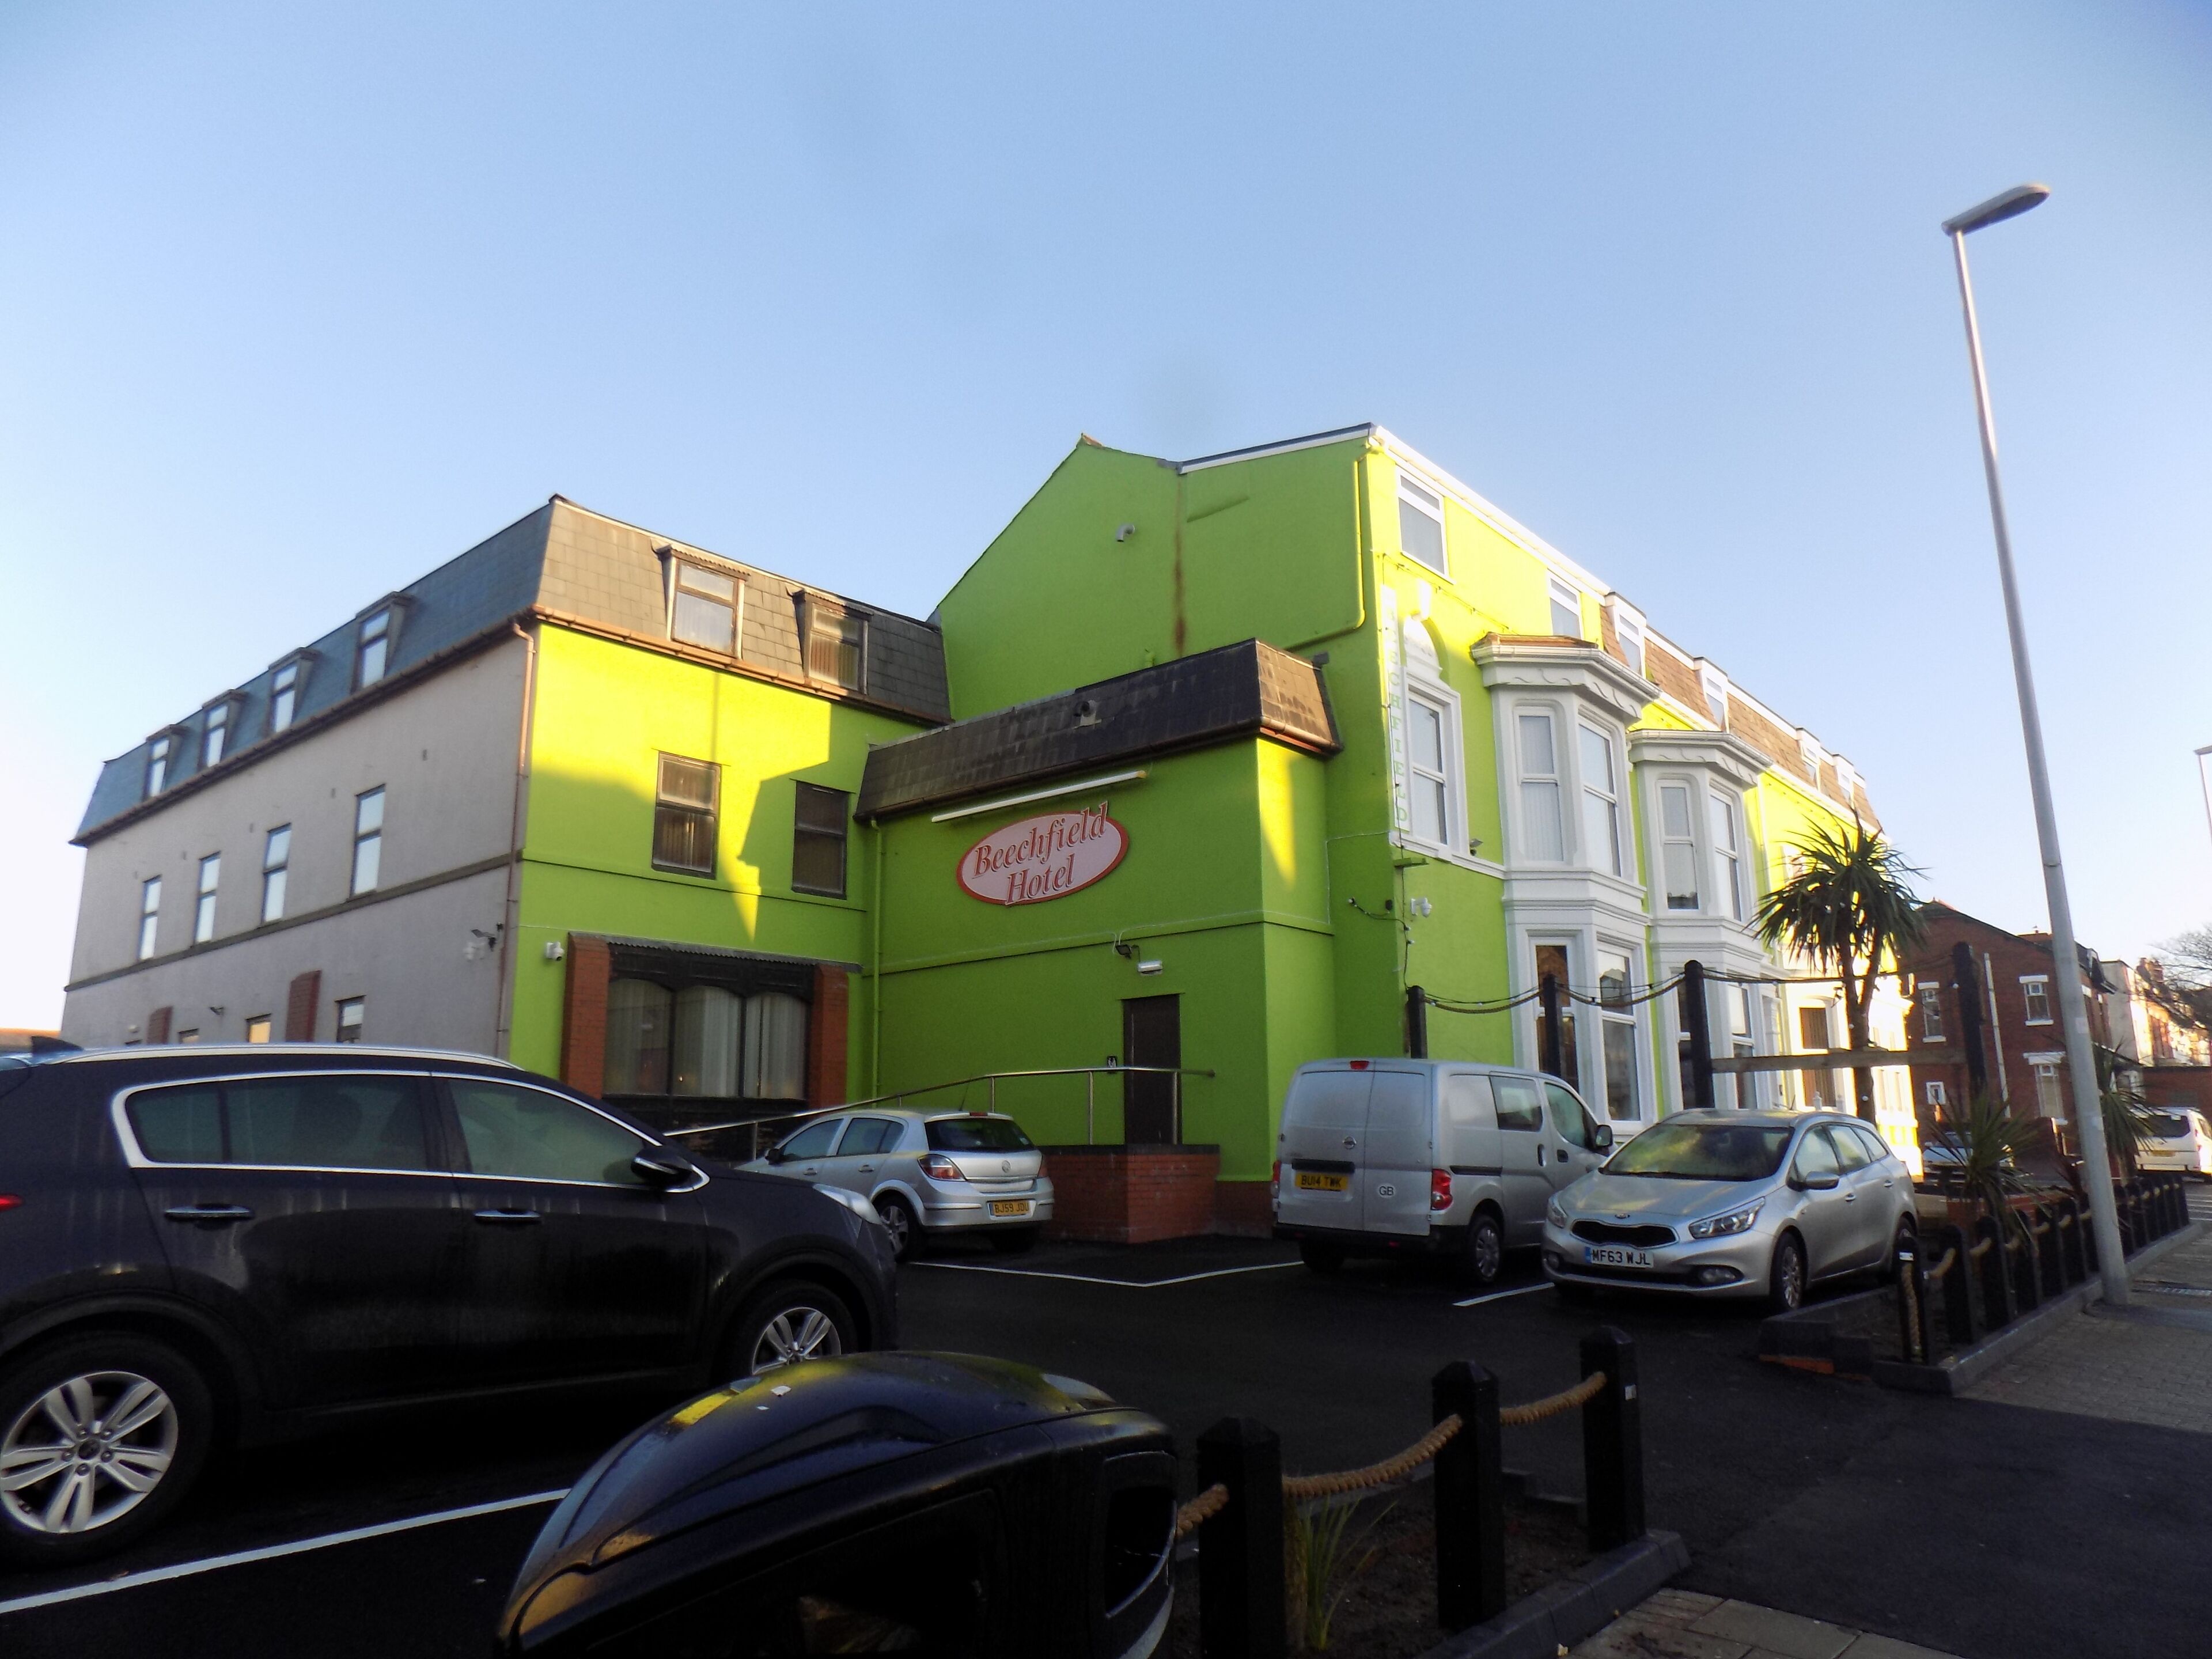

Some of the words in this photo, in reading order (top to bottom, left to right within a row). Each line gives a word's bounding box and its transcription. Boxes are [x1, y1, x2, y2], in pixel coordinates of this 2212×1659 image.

[972, 801, 1108, 879] Beechfield
[1005, 853, 1075, 906] Hotel
[1379, 1185, 1394, 1196] GB
[994, 1203, 1014, 1213] BJ59
[1592, 1249, 1623, 1263] MF63
[1626, 1251, 1651, 1266] WJL
